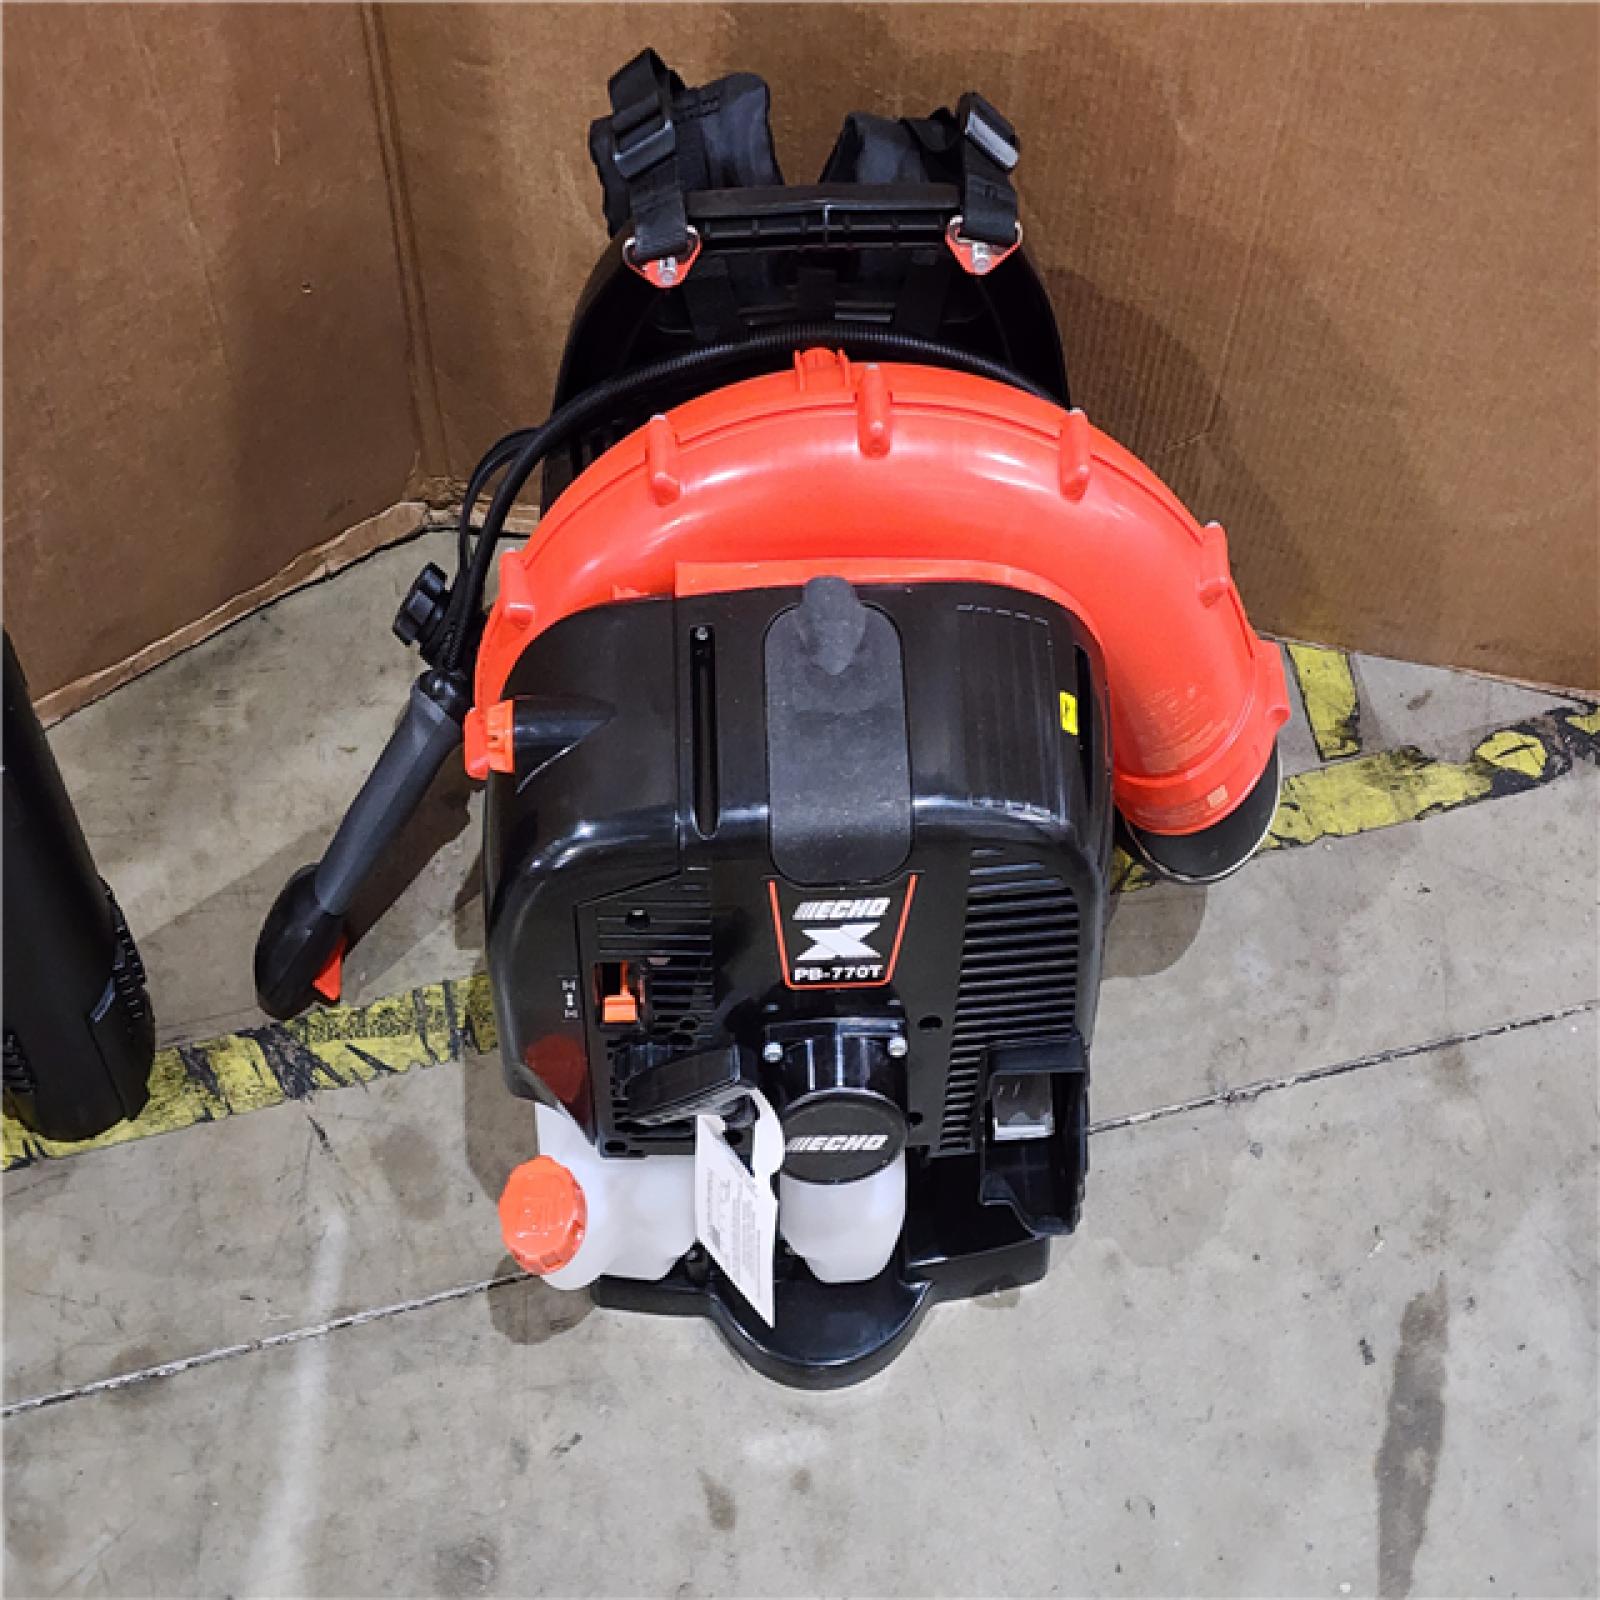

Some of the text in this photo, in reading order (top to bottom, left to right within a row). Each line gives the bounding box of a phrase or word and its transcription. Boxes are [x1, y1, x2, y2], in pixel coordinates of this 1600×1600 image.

[798, 897, 890, 920] ECHO
[794, 965, 883, 981] PB-770T
[795, 1134, 888, 1151] ECHO
